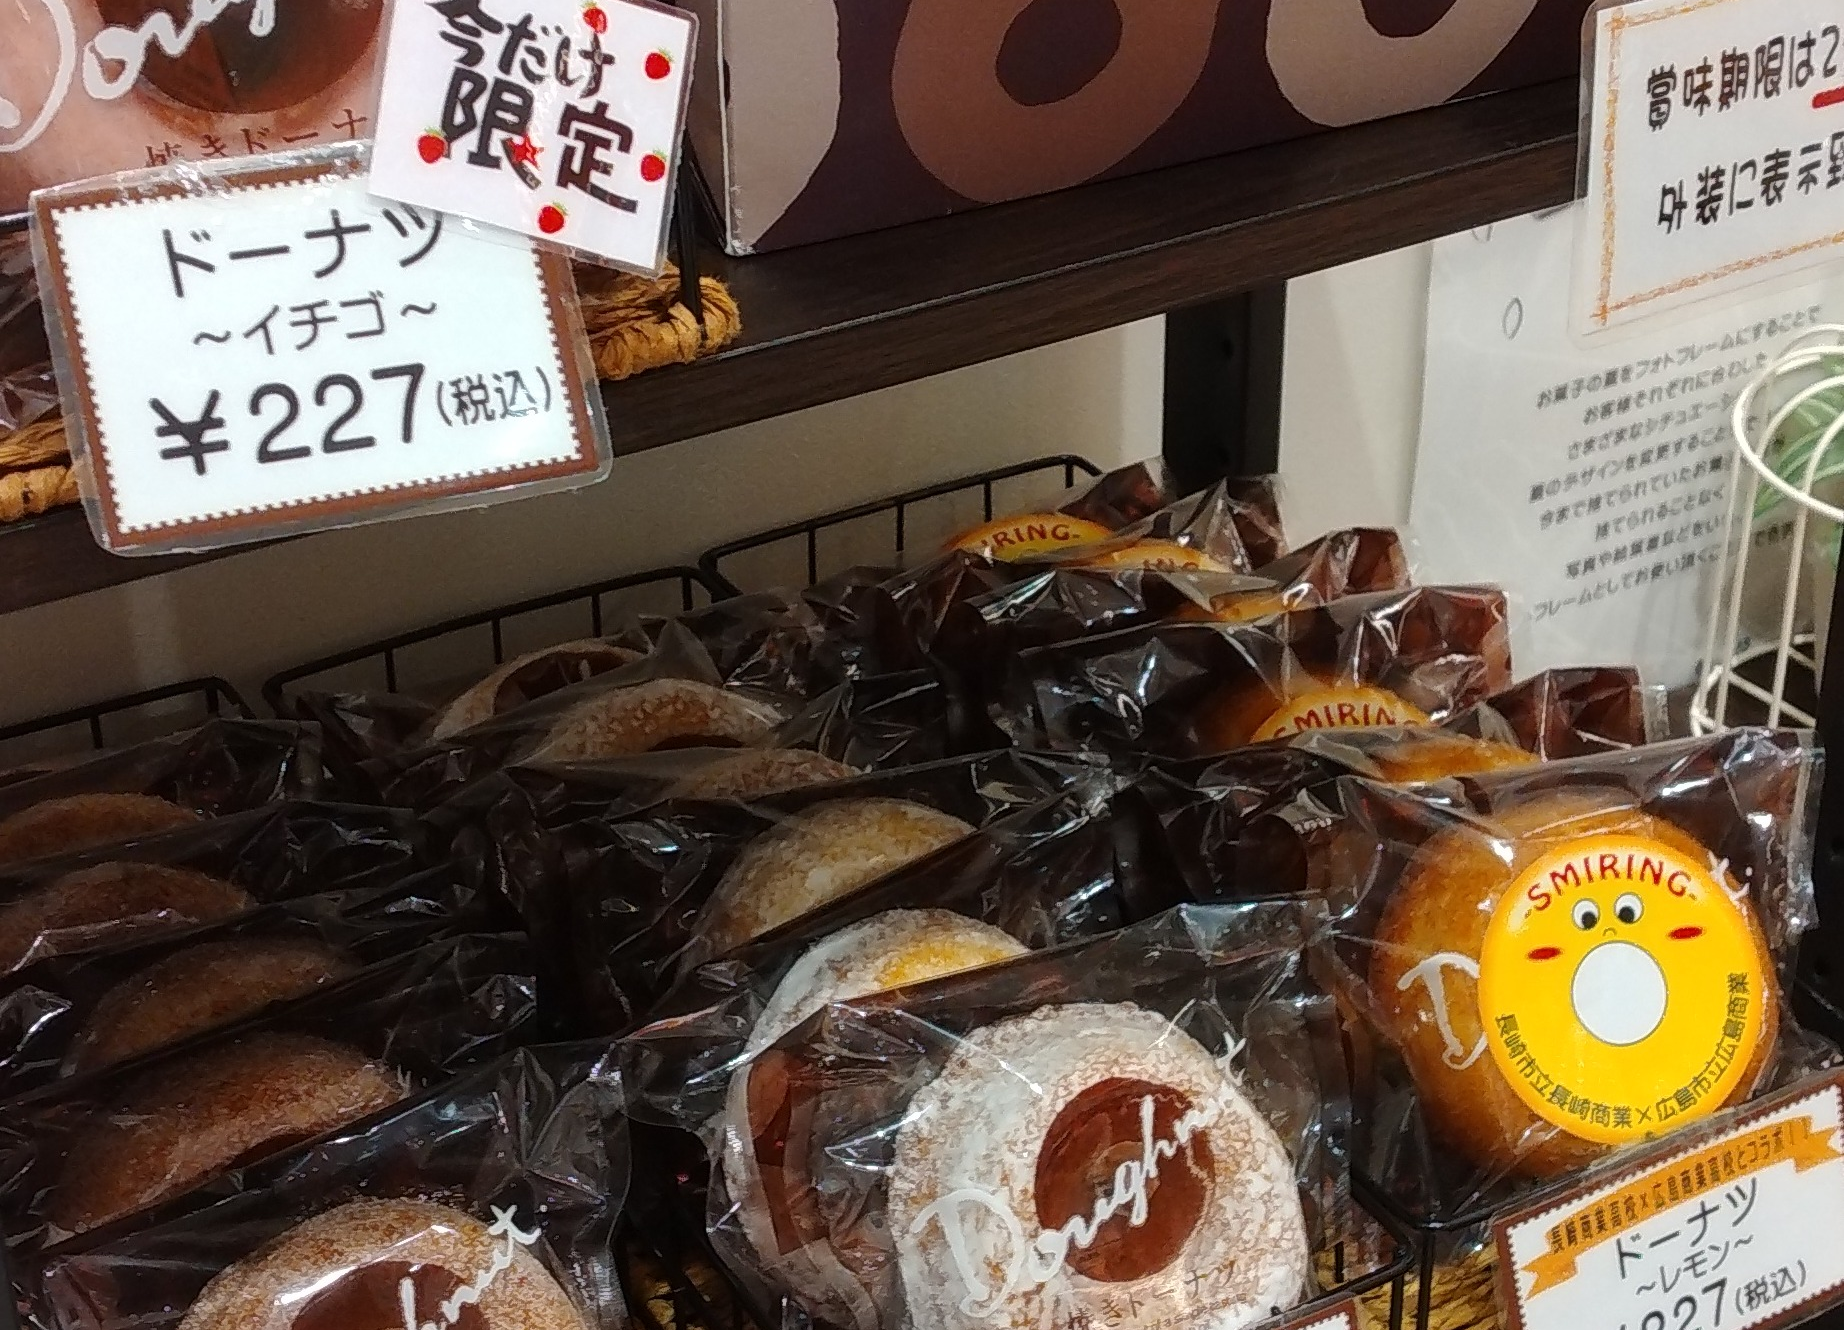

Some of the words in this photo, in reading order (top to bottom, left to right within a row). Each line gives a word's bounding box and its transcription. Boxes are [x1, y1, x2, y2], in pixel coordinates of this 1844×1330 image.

[1647, 24, 1844, 131] 賞味期限は2
[441, 69, 638, 214] 限定
[161, 206, 443, 297] ドーナツ
[1616, 1176, 1758, 1280] ドーナツ
